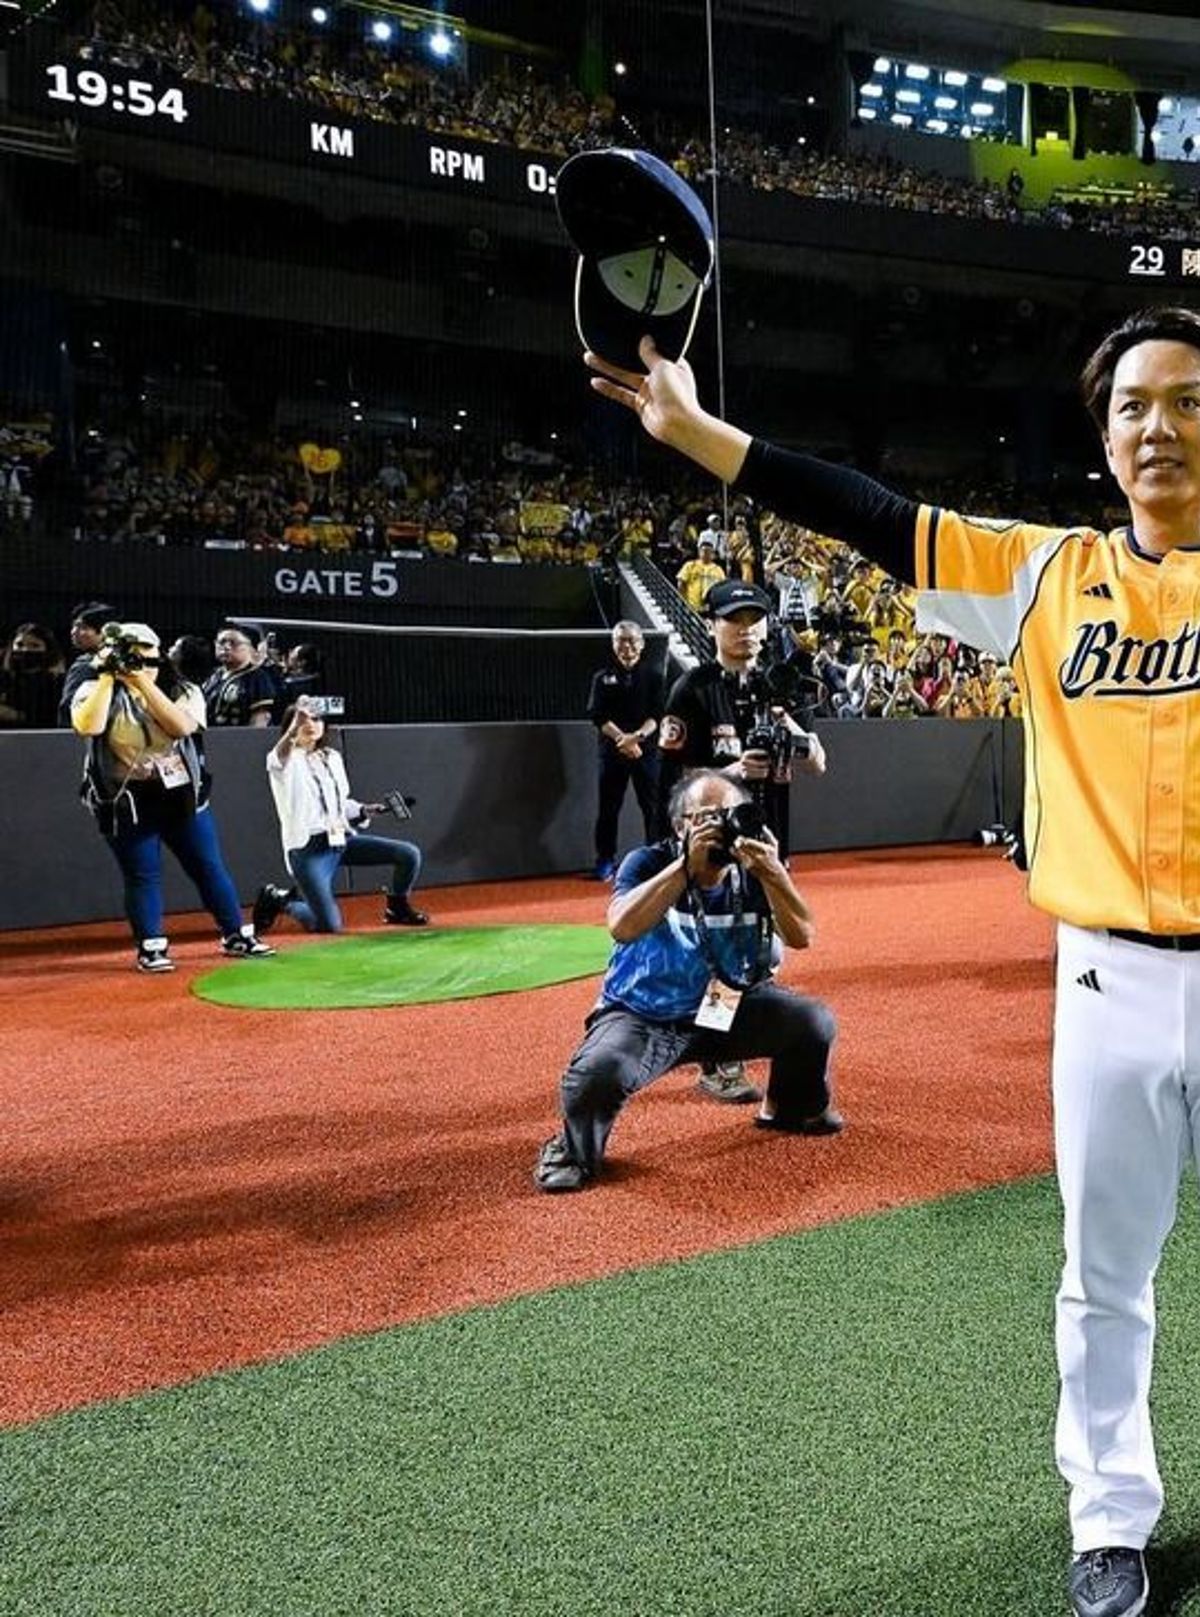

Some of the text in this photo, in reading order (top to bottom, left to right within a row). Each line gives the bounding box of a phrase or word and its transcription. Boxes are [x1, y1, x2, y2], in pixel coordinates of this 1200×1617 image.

[46, 64, 189, 123] 19:54
[310, 122, 354, 157] KM
[430, 146, 485, 183] RPM
[1128, 245, 1166, 276] 29
[275, 561, 399, 597] GATE 5
